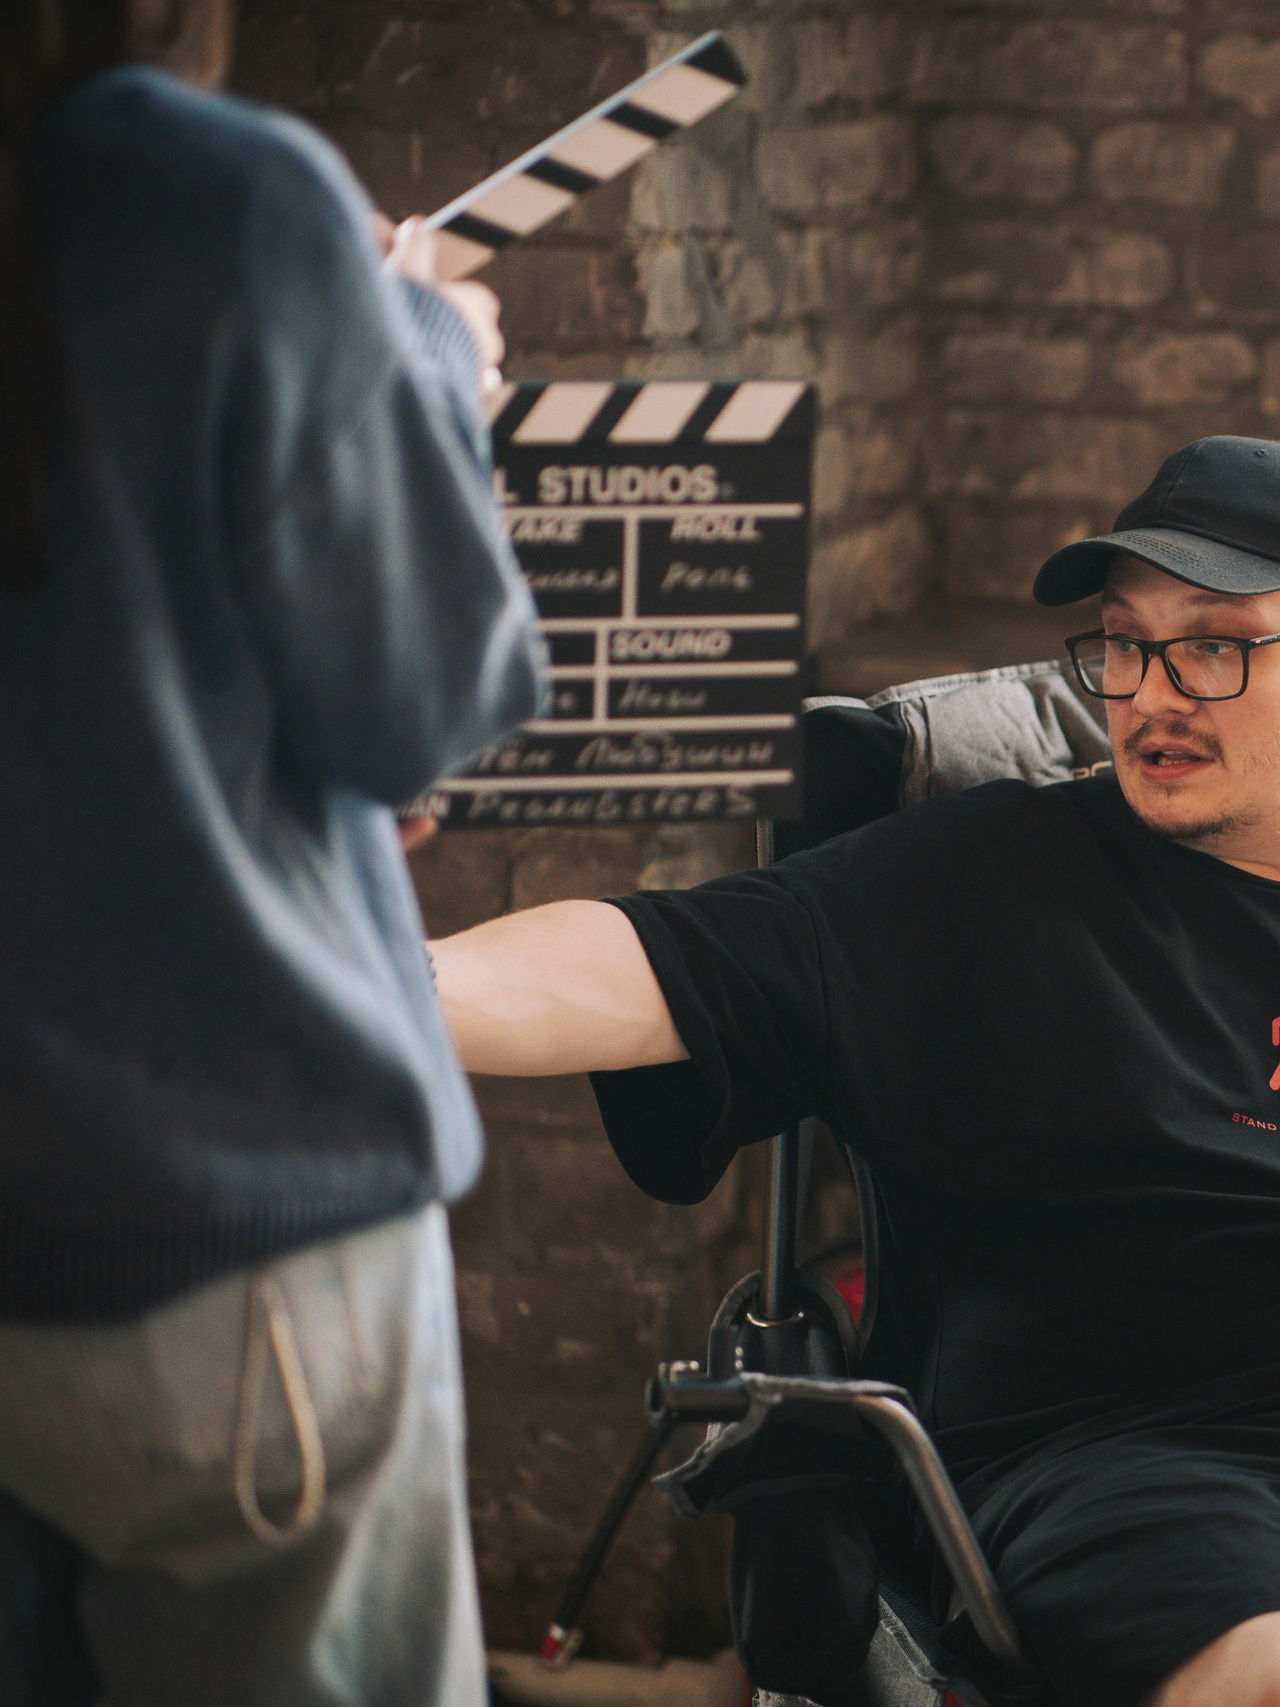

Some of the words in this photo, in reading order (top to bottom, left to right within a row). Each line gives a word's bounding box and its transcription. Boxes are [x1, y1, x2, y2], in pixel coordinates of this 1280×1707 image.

[539, 465, 719, 502] STUDIOS
[509, 517, 583, 543] AKE
[671, 516, 762, 542] ROLL
[613, 630, 733, 660] SOUND
[1232, 1112, 1277, 1131] STAND
